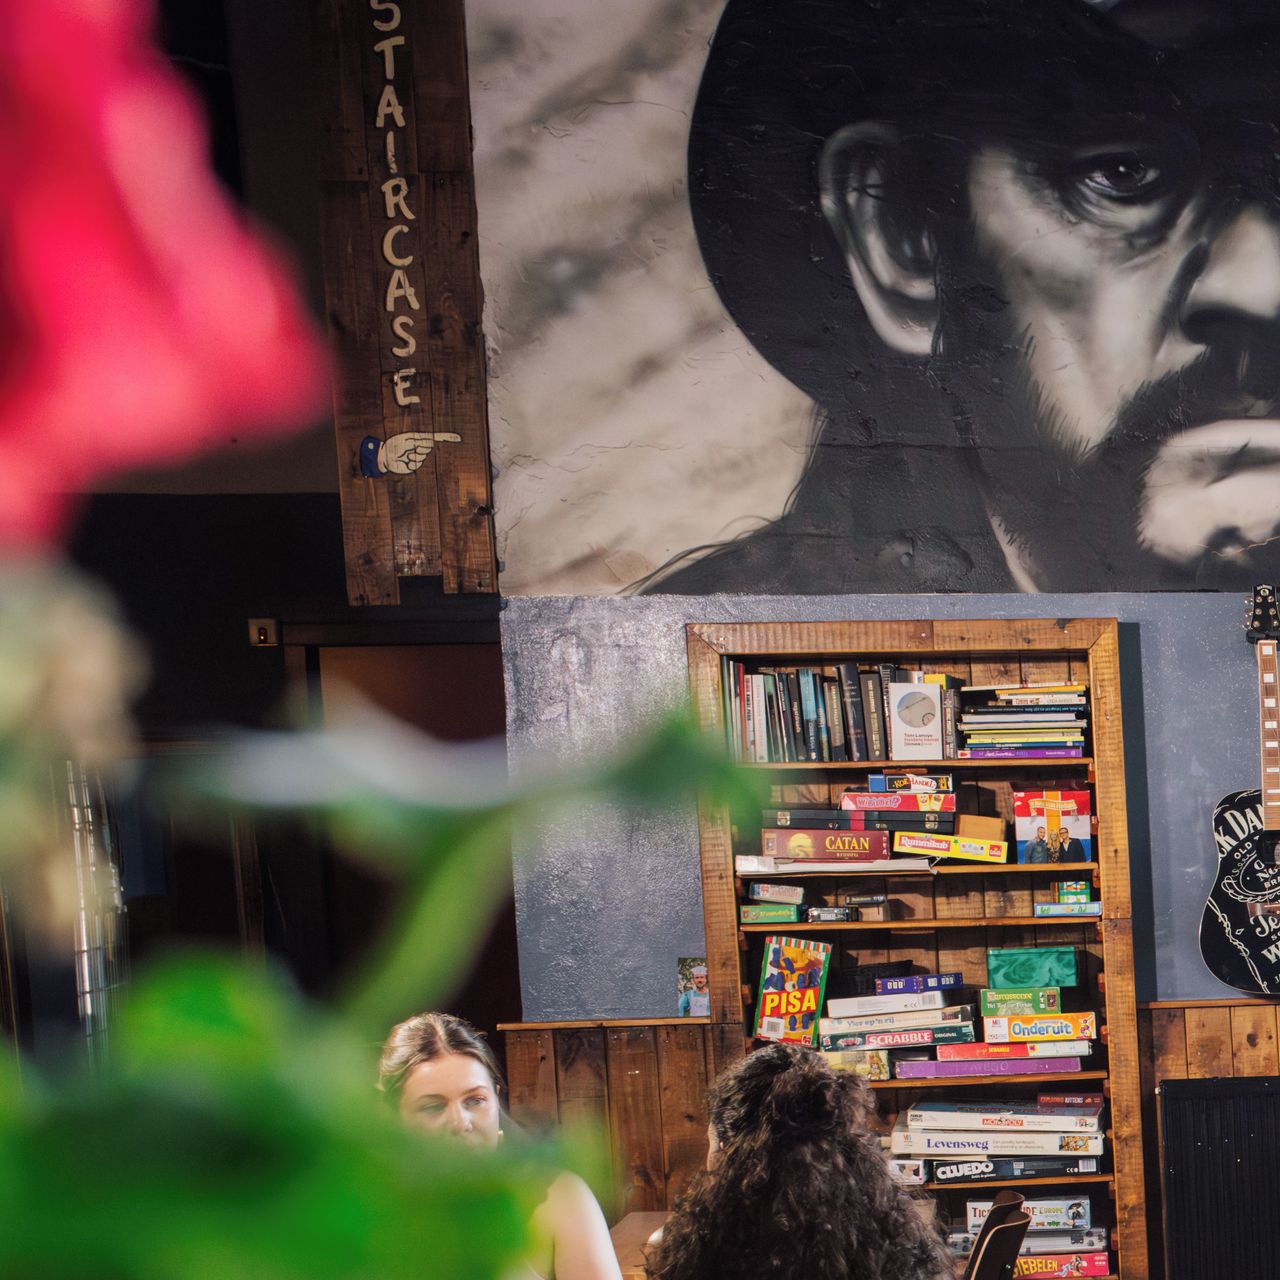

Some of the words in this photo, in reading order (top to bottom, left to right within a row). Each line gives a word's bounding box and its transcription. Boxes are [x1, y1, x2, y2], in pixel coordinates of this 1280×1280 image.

[371, 0, 421, 406] STAIRCASE
[825, 835, 869, 850] CATAN
[901, 836, 949, 851] Rummikub
[764, 988, 817, 1017] PISA
[847, 1019, 864, 1029] Vier
[1011, 1021, 1073, 1037] Onderuit
[868, 1031, 932, 1047] SCRABBLE
[926, 1138, 990, 1151] Levensweg
[936, 1161, 994, 1180] CLUEDO
